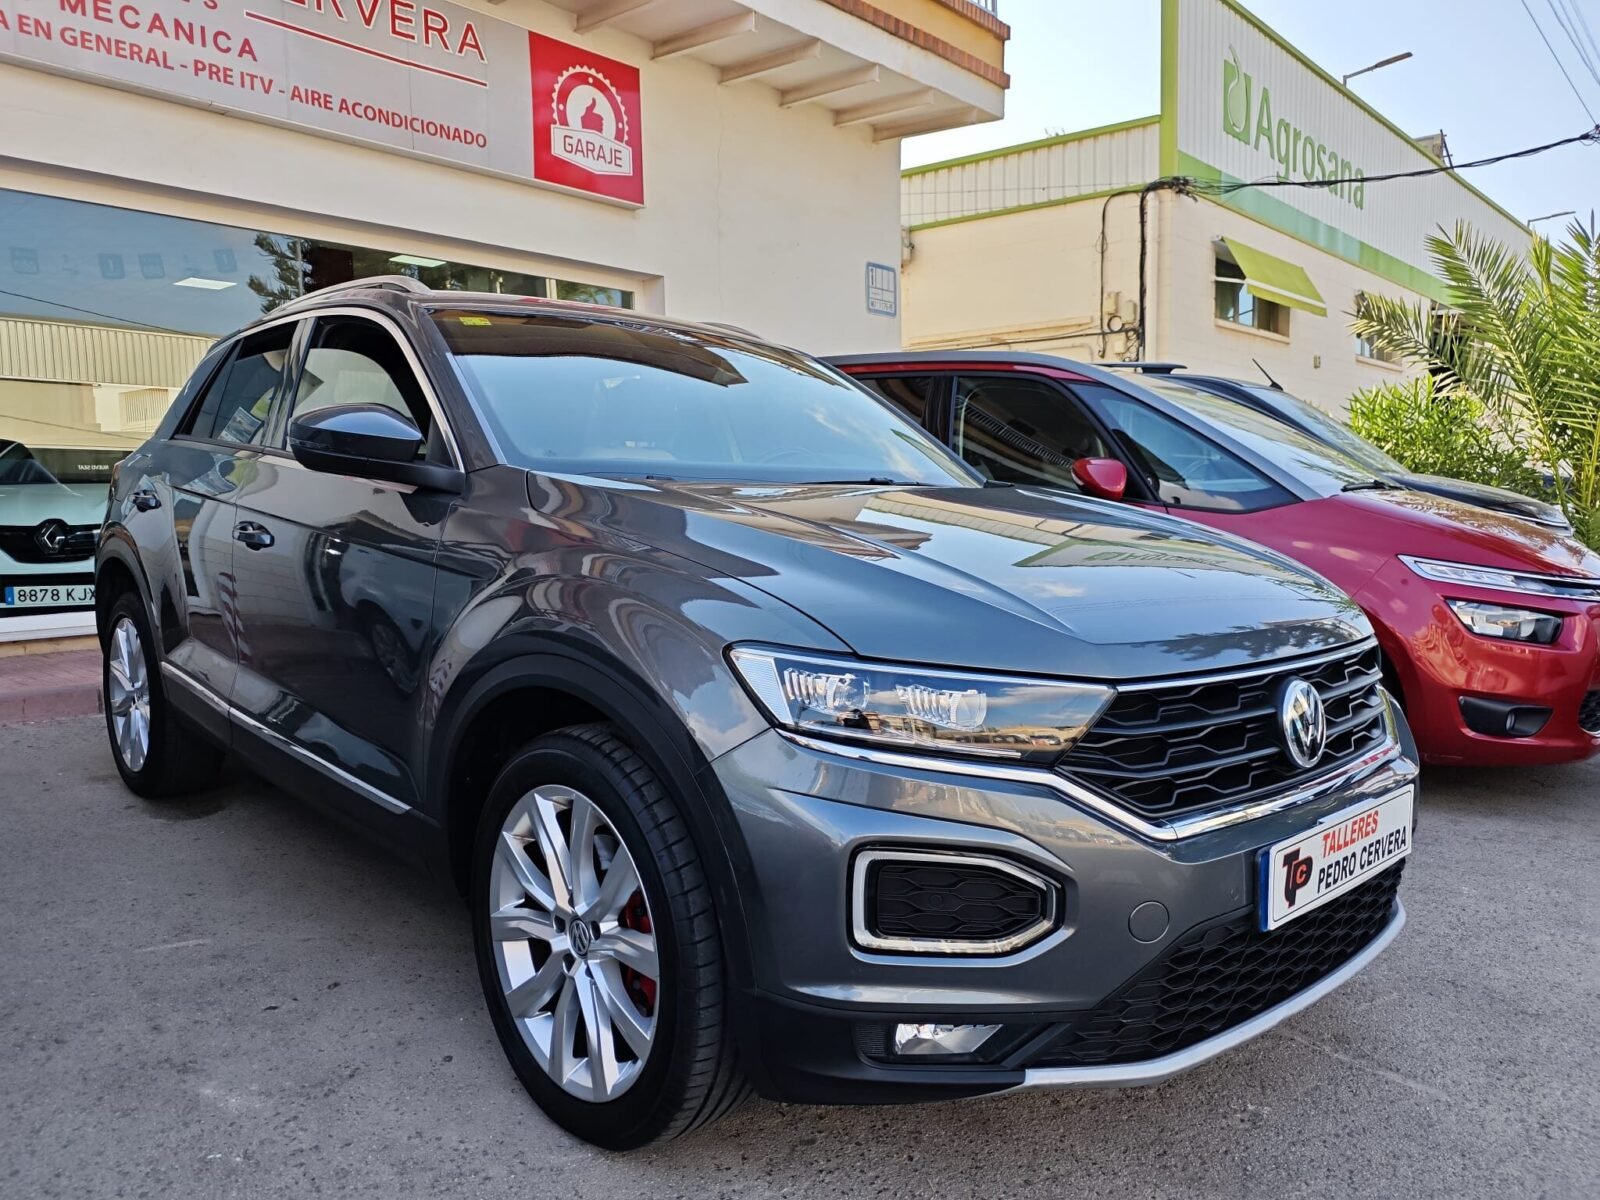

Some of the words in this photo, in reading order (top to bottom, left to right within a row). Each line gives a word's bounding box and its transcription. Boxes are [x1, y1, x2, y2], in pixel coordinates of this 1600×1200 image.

[60, 0, 257, 62] MECANICA
[18, 14, 52, 40] EN
[60, 27, 174, 70] GENERAL
[193, 59, 234, 86] PRE
[240, 71, 273, 94] ITV
[290, 85, 333, 111] AIRE
[338, 98, 487, 148] ACONDICIONADO
[563, 135, 623, 168] GARAJE
[1254, 86, 1365, 211] Agrosana
[17, 589, 60, 602] 8878
[1317, 851, 1357, 894] PEDRO
[1360, 825, 1407, 870] CERVERA
[1323, 810, 1379, 858] TALLERES
